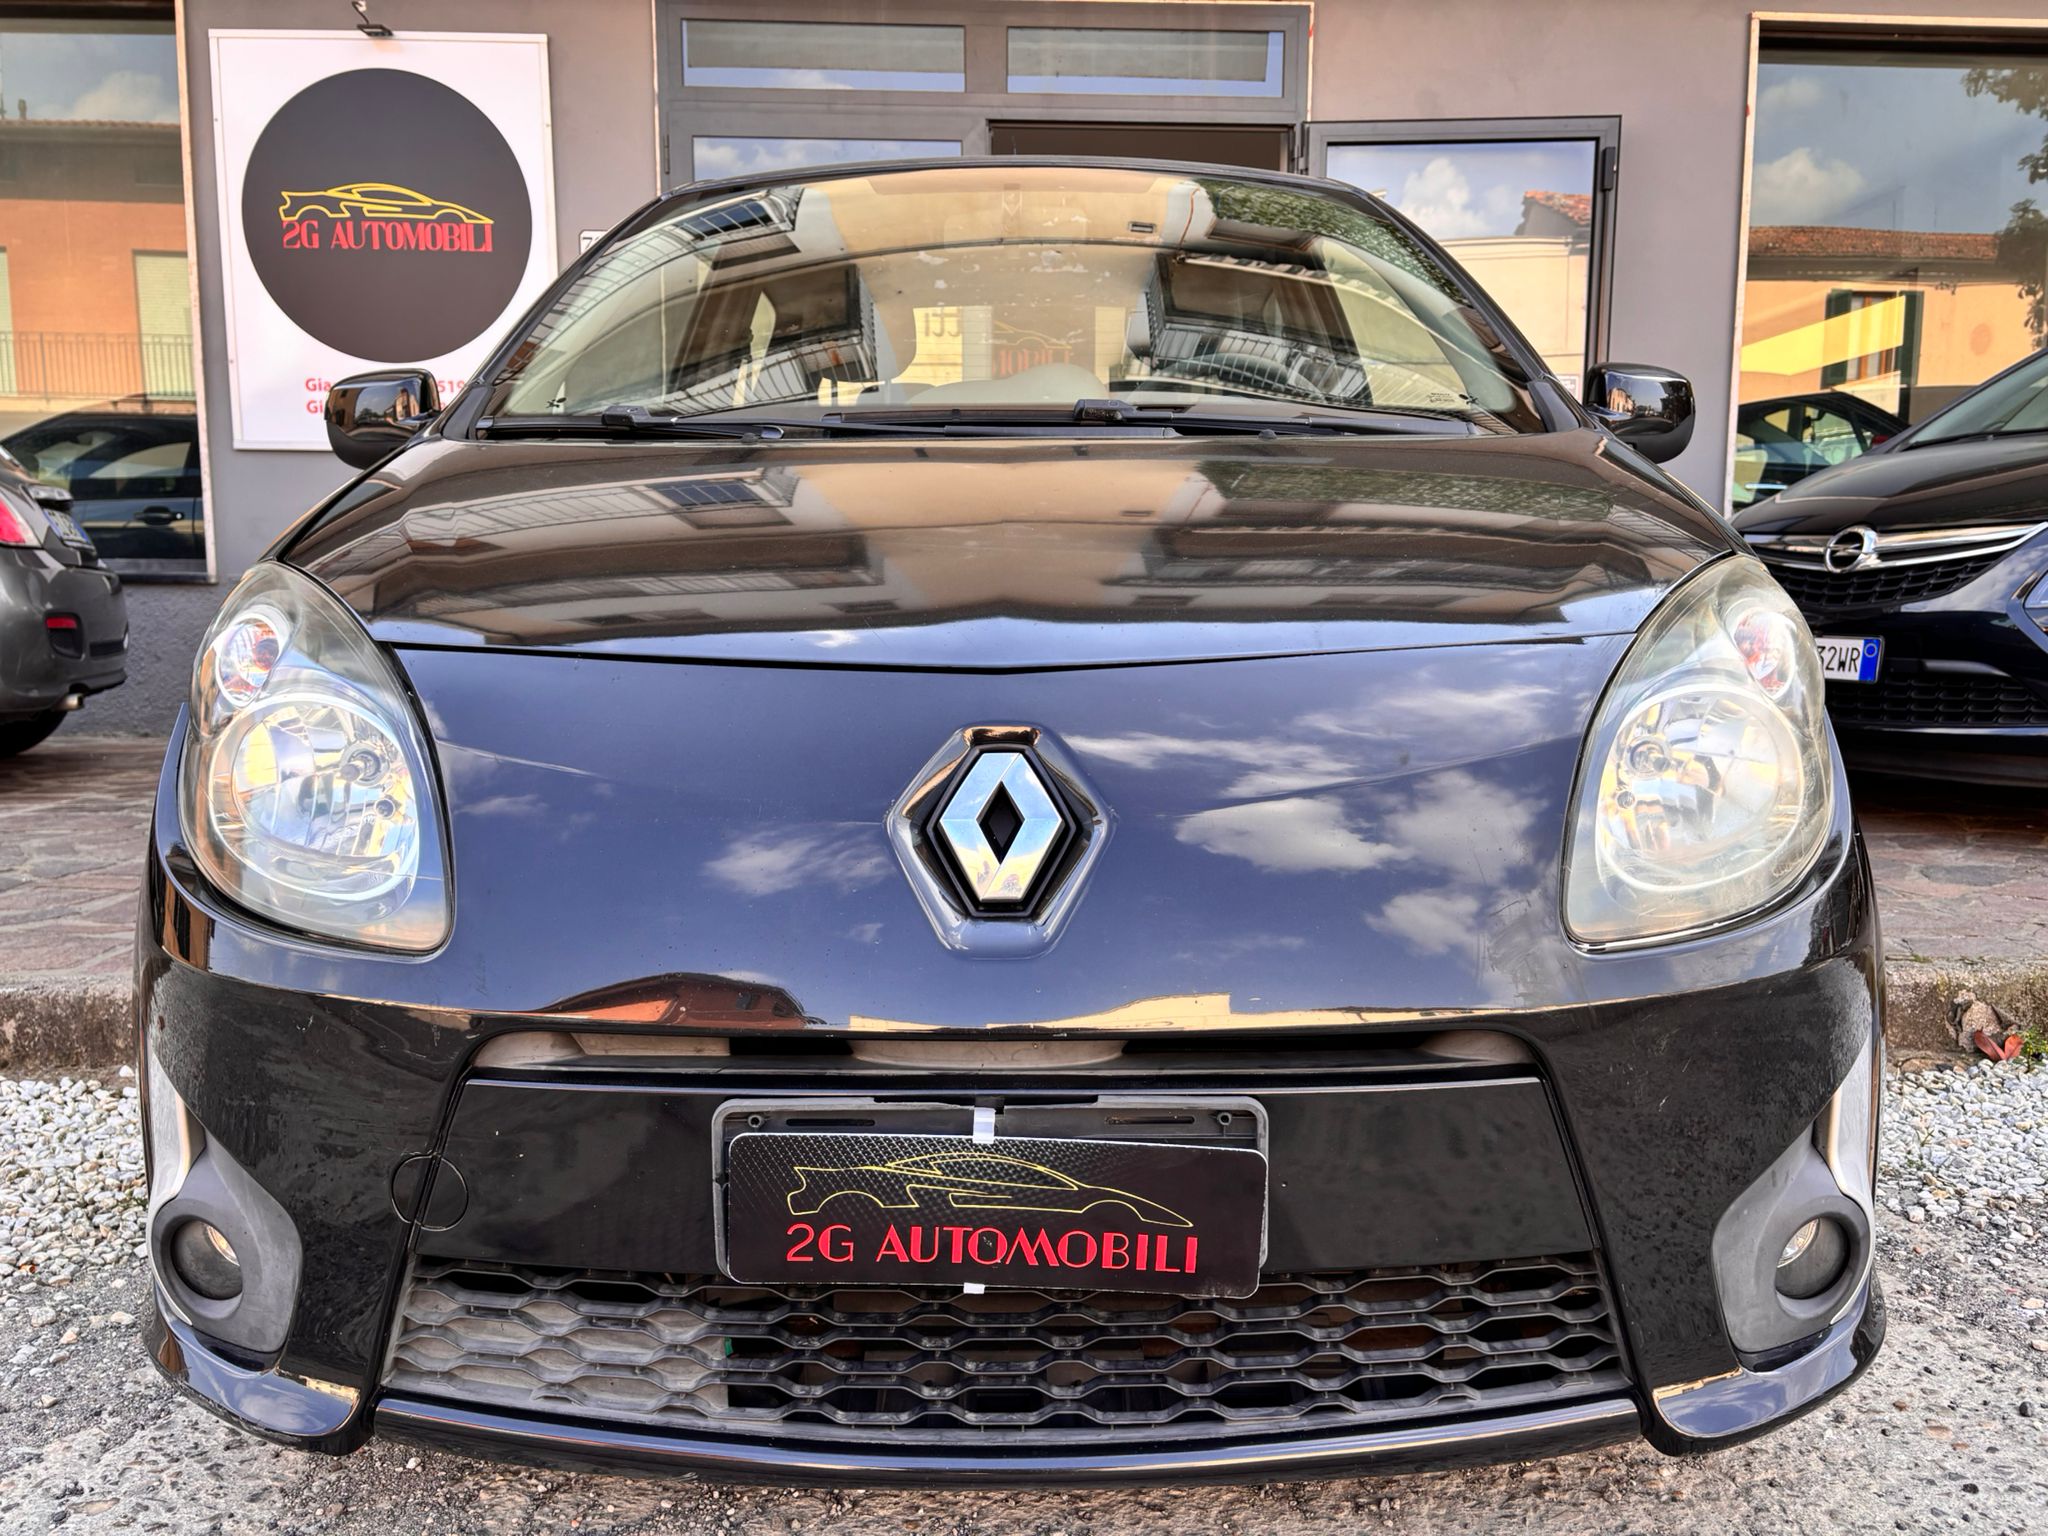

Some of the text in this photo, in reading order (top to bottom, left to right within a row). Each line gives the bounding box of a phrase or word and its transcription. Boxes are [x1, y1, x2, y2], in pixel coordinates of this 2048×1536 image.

[282, 219, 493, 252] 2G AUTOMOBILI
[786, 1223, 1199, 1274] 2G AUTOMOBILI
